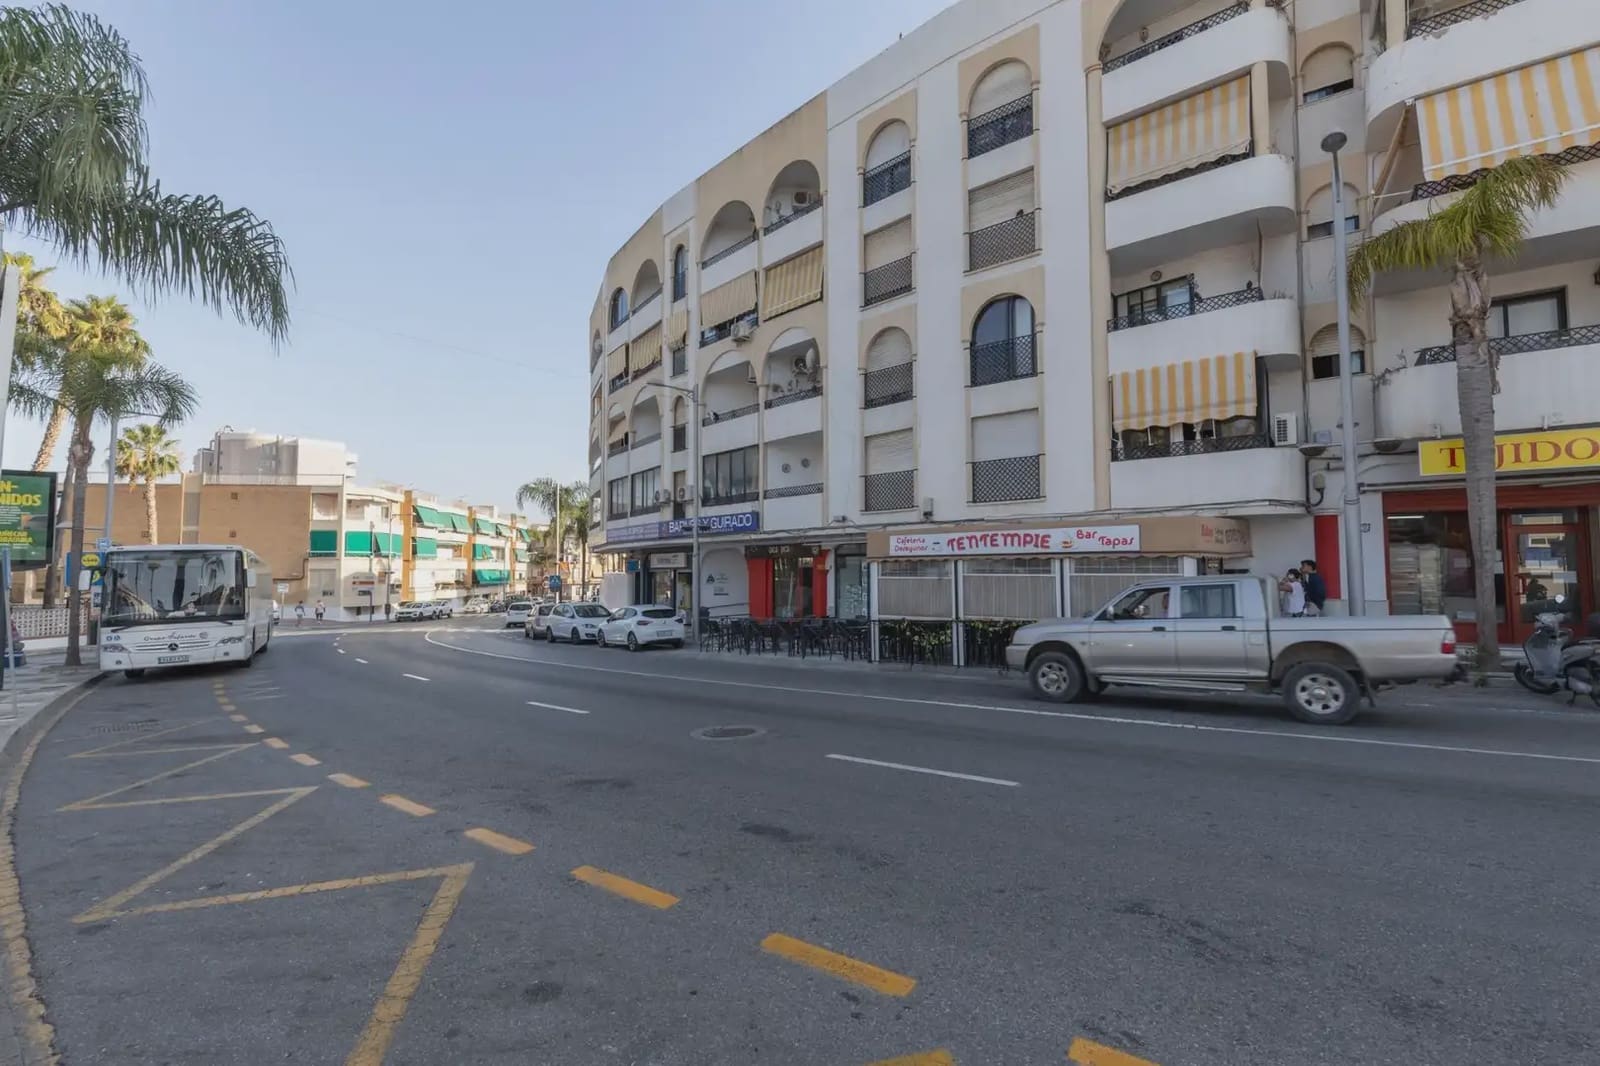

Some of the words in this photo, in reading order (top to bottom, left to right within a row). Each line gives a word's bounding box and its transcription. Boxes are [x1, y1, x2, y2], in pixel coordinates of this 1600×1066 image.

[1439, 437, 1599, 469] TJIDO
[711, 514, 753, 529] GUIRADO
[1076, 529, 1098, 540] Bar
[1098, 535, 1134, 549] Tapas
